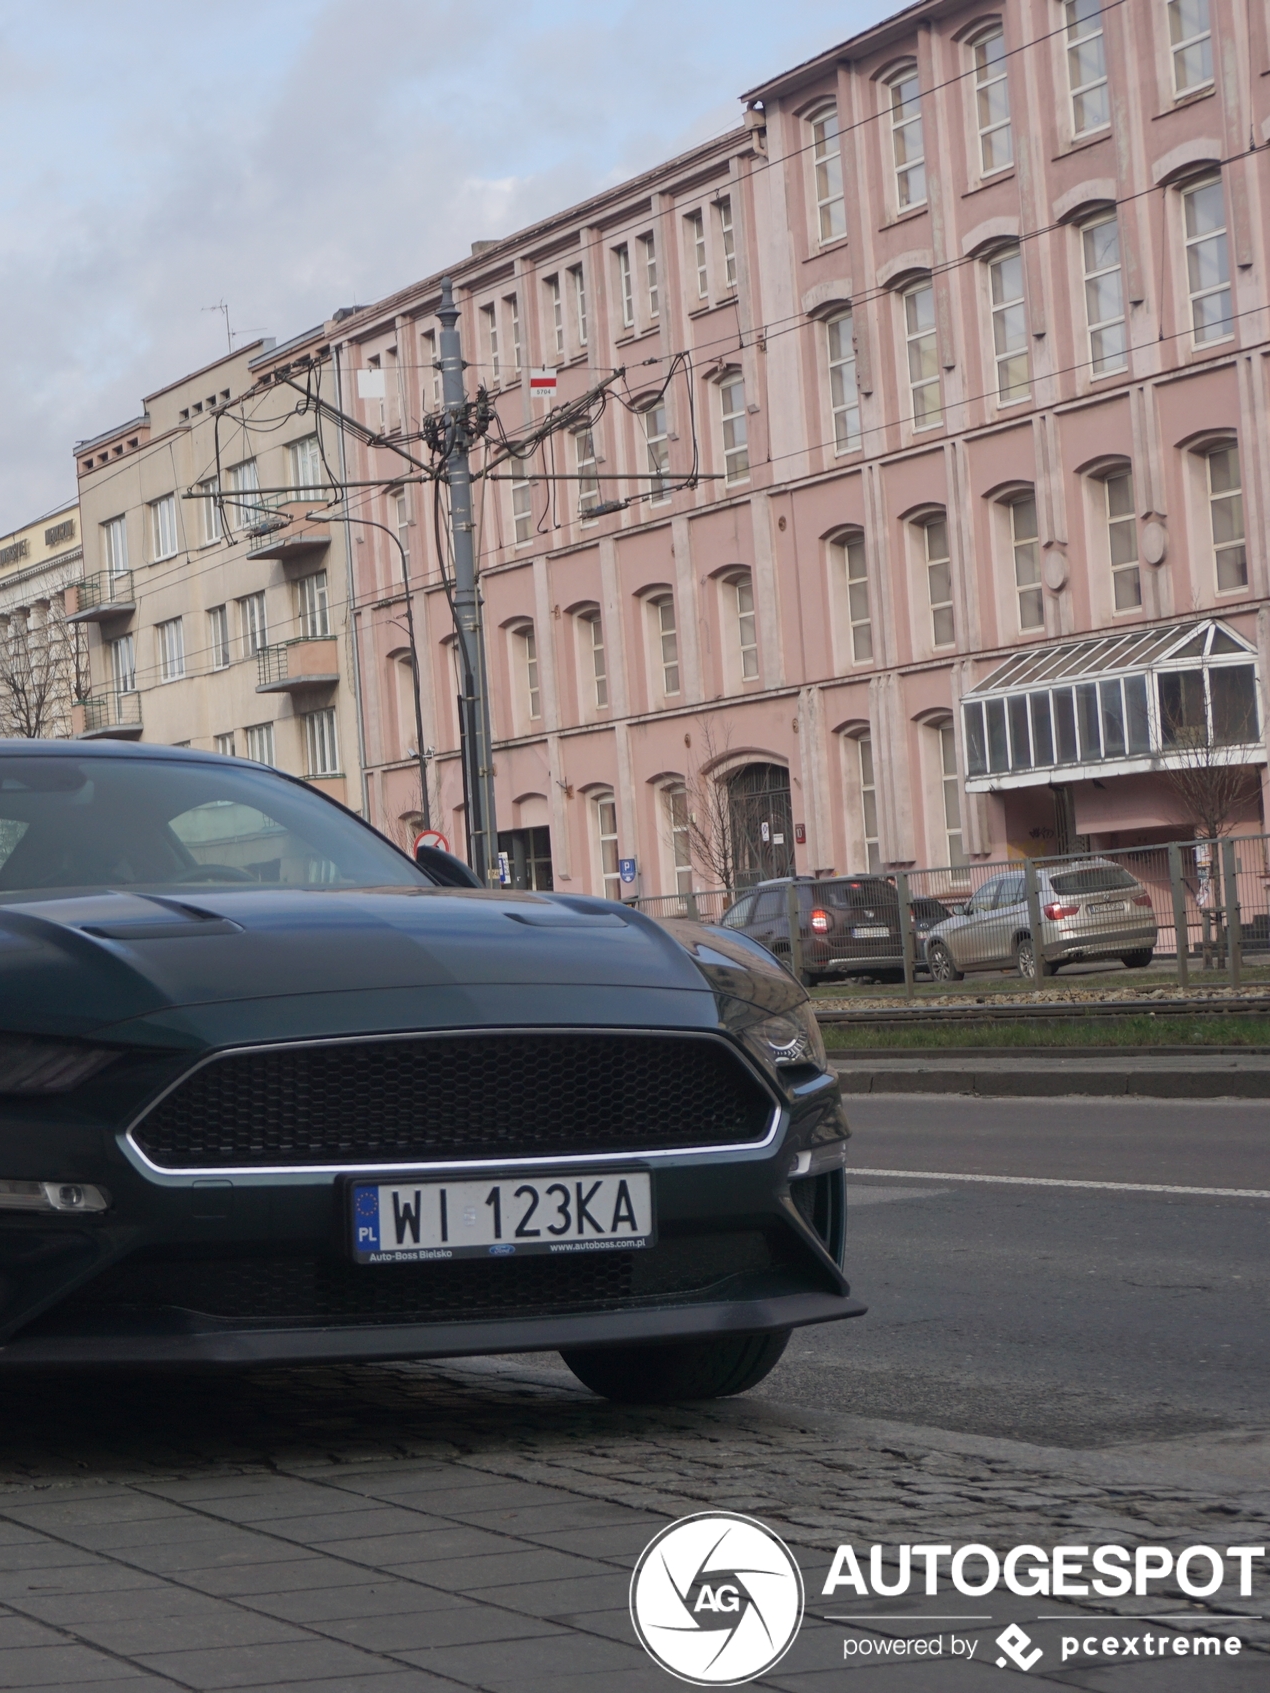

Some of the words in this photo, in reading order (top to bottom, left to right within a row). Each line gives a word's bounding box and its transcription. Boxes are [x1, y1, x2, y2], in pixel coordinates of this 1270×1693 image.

[391, 1188, 448, 1245] WI
[484, 1178, 639, 1240] 123KA
[358, 1226, 377, 1242] PL
[550, 1238, 646, 1252] www.autoboss.com.pl
[370, 1251, 418, 1261] Auto-Boss
[419, 1249, 453, 1259] Bielsko
